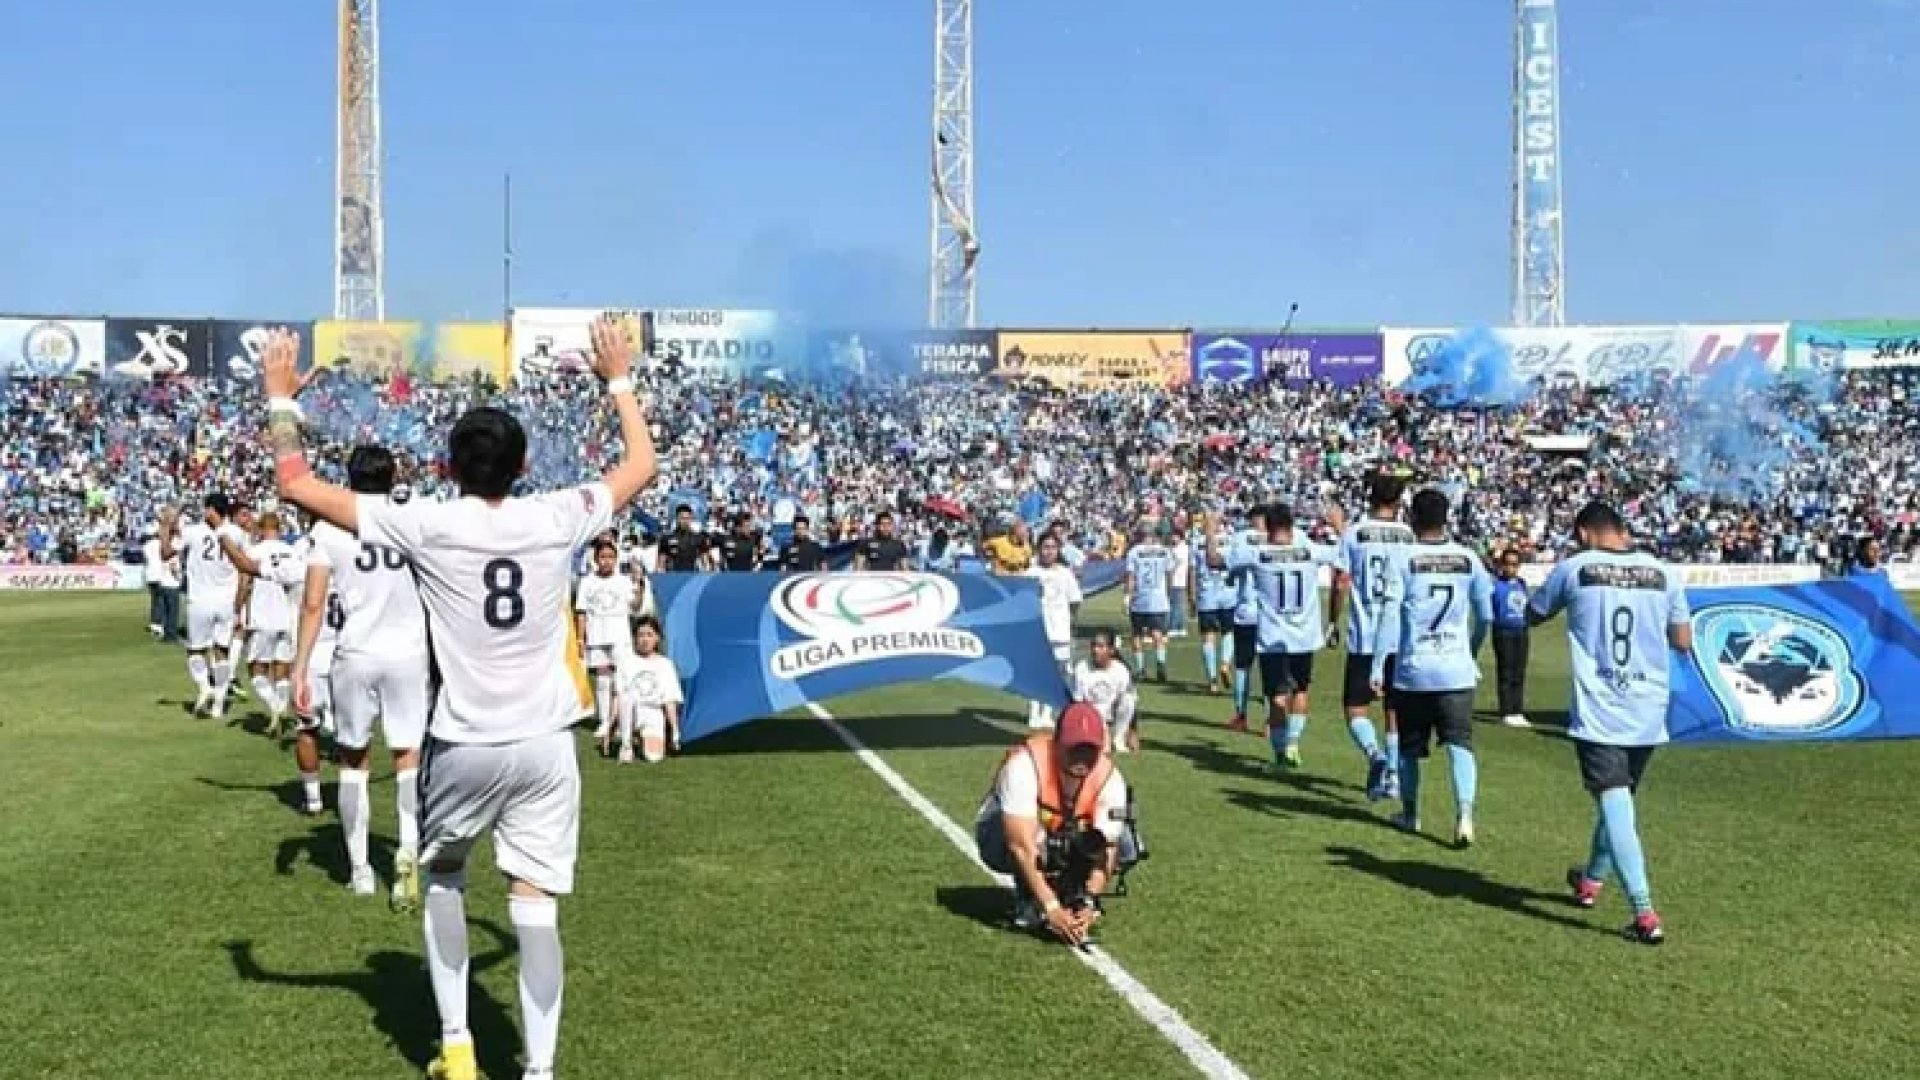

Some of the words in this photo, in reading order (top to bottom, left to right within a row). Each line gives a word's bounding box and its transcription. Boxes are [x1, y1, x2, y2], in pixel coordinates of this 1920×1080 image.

[1526, 22, 1554, 182] ICEST
[652, 339, 774, 358] ESTADIO
[484, 557, 525, 629] 8
[1274, 570, 1304, 614] 11
[1428, 584, 1454, 631] 7
[777, 641, 845, 672] LIGA
[851, 631, 978, 654] PREMIER
[1612, 605, 1634, 666] 8
